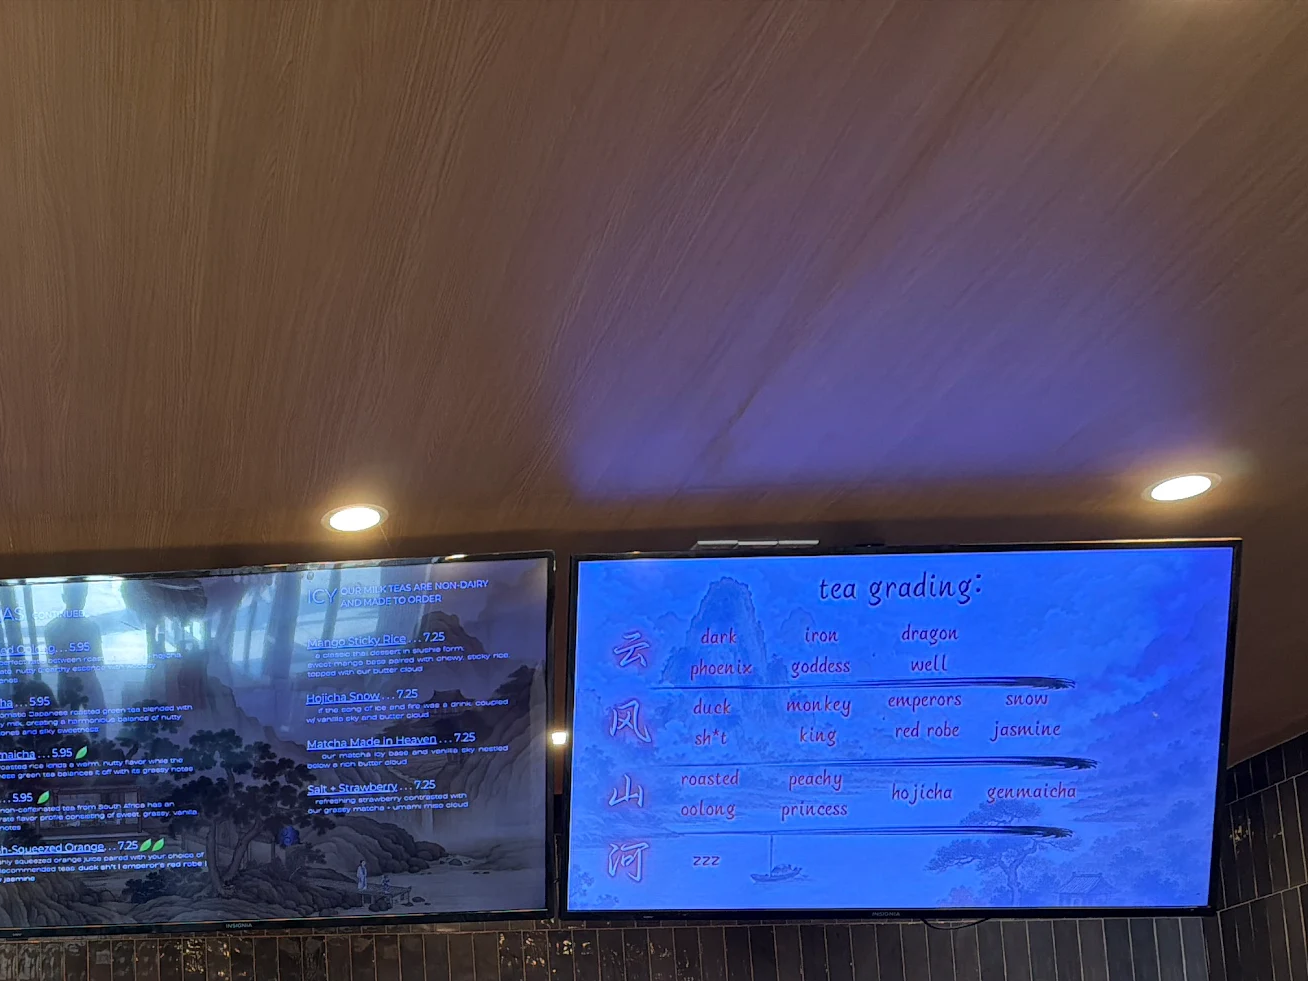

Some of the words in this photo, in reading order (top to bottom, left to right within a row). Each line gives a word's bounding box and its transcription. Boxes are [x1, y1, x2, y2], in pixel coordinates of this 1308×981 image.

[307, 587, 337, 604] ICY
[341, 585, 363, 595] OUR
[364, 584, 387, 594] MILK
[389, 583, 412, 593] TEAS
[413, 581, 433, 592] ARE
[435, 580, 489, 591] NON-DAIRY
[819, 578, 857, 600] tea
[869, 571, 982, 606] grading:
[341, 597, 362, 607] AND
[364, 596, 392, 606] MADE
[393, 595, 407, 605] TO
[408, 594, 442, 605] ORDER
[307, 638, 346, 649] Mango
[348, 636, 381, 647] Sticky
[383, 634, 407, 645] Rice
[423, 632, 446, 643] 7.25
[701, 627, 737, 645] dark
[805, 626, 839, 644] iron
[901, 622, 959, 646] dragon
[613, 631, 651, 668] 云
[690, 659, 753, 681] phoenix
[791, 656, 851, 678] goddess
[910, 654, 948, 672] well
[29, 697, 51, 707] 5.95
[306, 692, 347, 704] Hojicha
[349, 691, 380, 702] Snow
[396, 689, 419, 699] 7.25
[888, 695, 962, 716] emperors
[1005, 692, 1049, 706] snow
[693, 698, 732, 715] duck
[786, 696, 852, 717] monkey
[609, 700, 652, 744] 风
[895, 721, 920, 738] red
[927, 720, 960, 737] robe
[307, 738, 347, 749] Matcha
[350, 736, 381, 747] Made
[382, 736, 393, 746] in
[395, 734, 437, 746] Heaven
[454, 732, 476, 743] 7.25
[799, 726, 837, 747] king
[989, 721, 1061, 743] jasmine
[52, 748, 73, 759] 5.95
[681, 769, 740, 786] roasted
[789, 770, 843, 792] peachy
[307, 784, 328, 795] Salt
[339, 781, 398, 794] Strawberry
[414, 780, 436, 790] 7.25
[608, 773, 645, 808] 山
[892, 782, 953, 805] hojicha
[987, 781, 1077, 804] genmaicha
[12, 792, 33, 803] 5.95
[680, 800, 736, 820] oolong
[781, 801, 848, 821] princess
[66, 841, 105, 853] Orange
[117, 840, 139, 851] 7.25
[608, 842, 649, 882] 河
[693, 855, 721, 867] zzz
